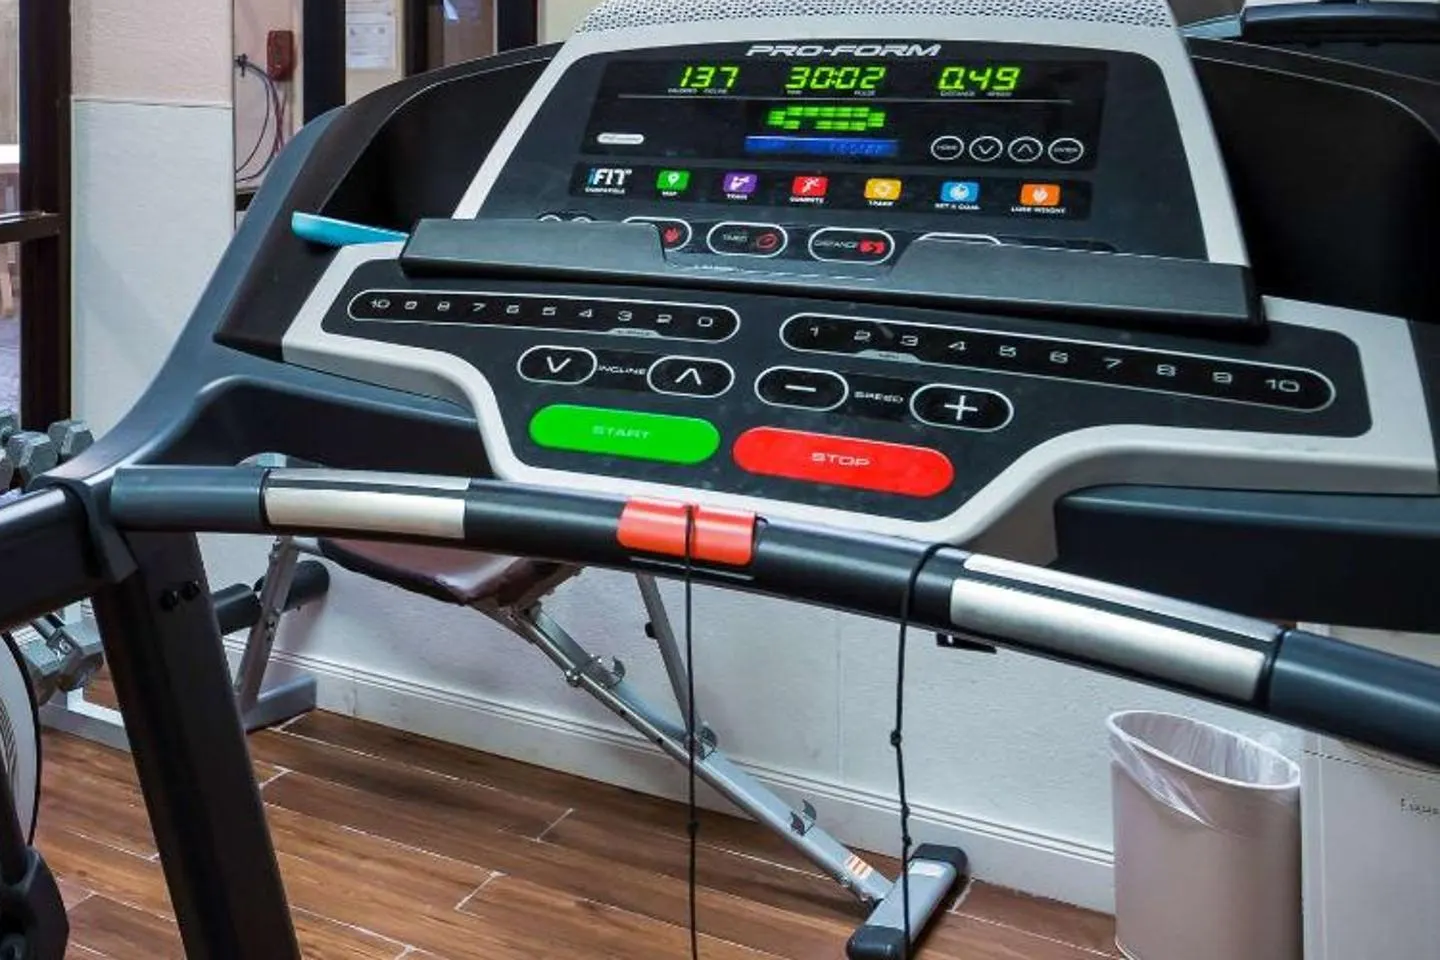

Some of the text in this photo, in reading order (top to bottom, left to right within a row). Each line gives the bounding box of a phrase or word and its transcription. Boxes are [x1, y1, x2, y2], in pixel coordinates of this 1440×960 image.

[744, 43, 942, 57] PRO-FORM
[679, 65, 740, 89] 137
[592, 424, 651, 440] START
[810, 451, 873, 467] STOP
